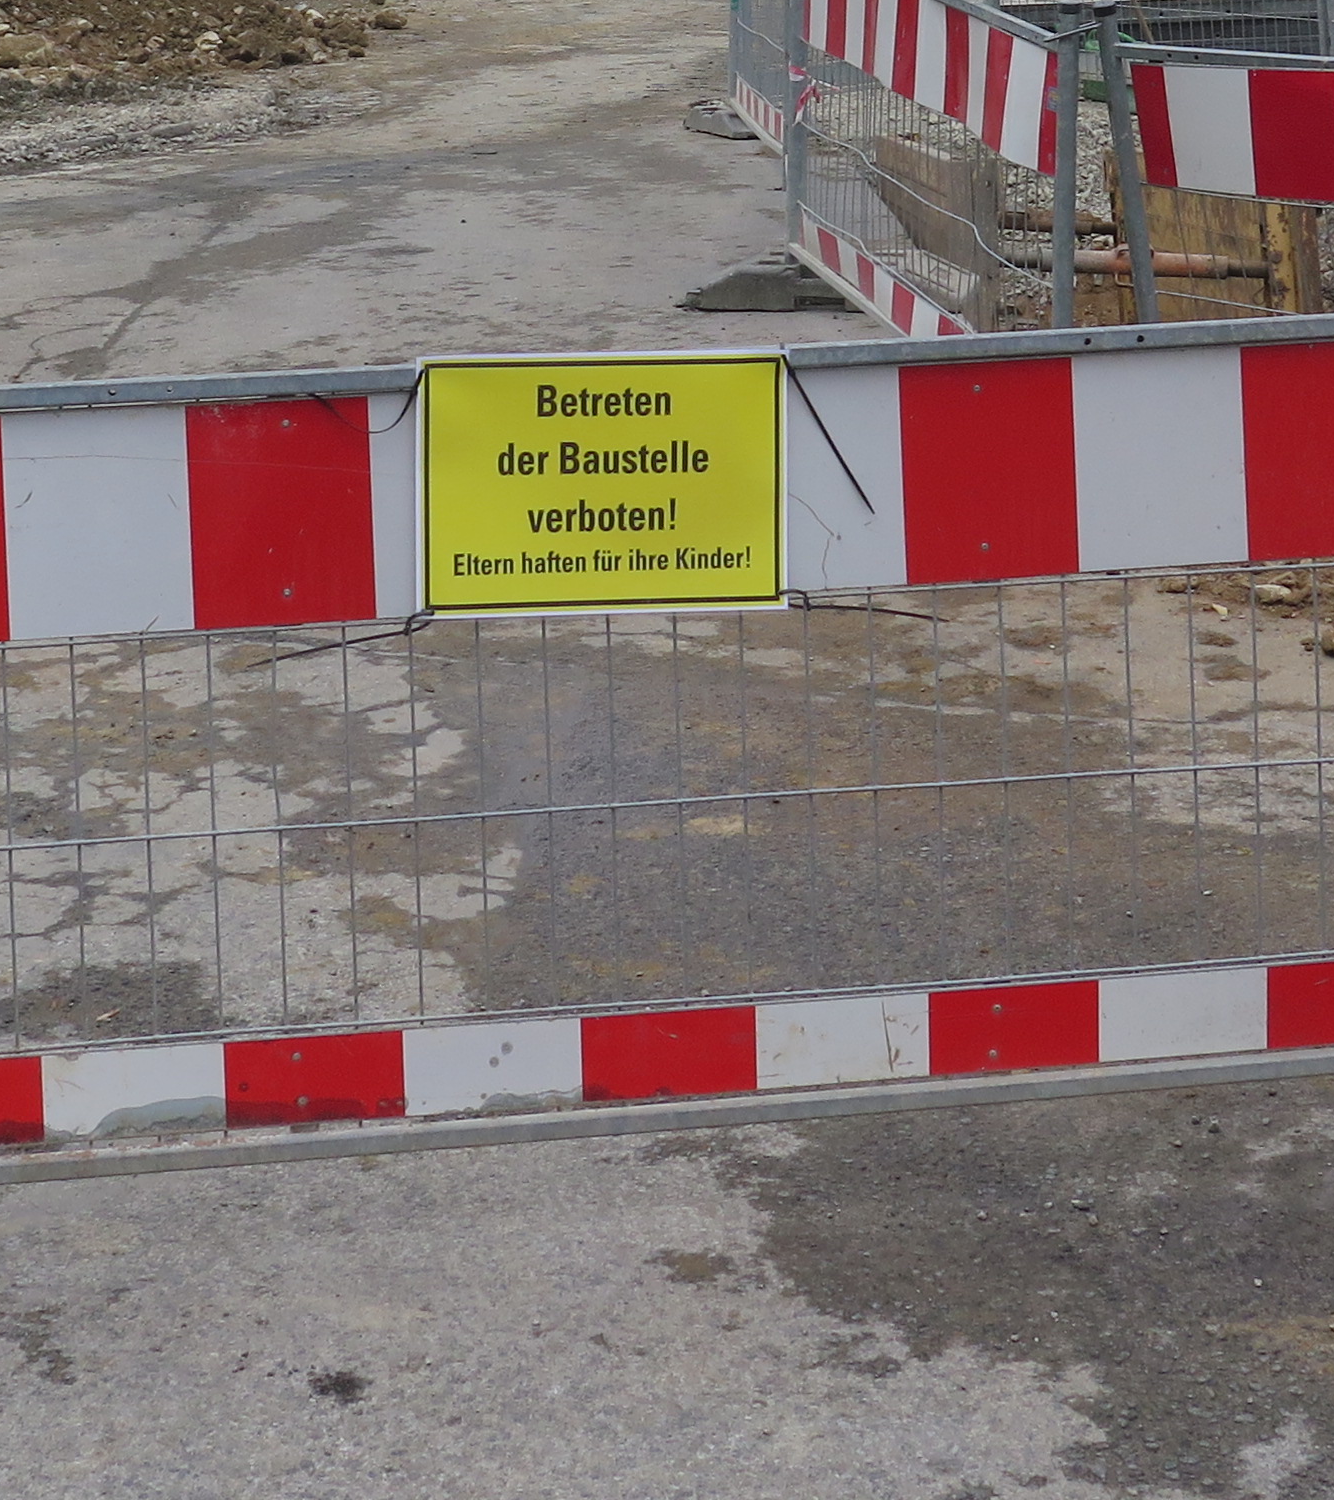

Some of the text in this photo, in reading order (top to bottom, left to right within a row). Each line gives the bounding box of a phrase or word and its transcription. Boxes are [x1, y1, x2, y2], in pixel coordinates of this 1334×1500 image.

[536, 384, 672, 418] Betreten
[497, 440, 710, 476] der Baustelle
[527, 498, 677, 533] verboten!
[453, 545, 751, 577] Eltern haften für ihre Kinder!
